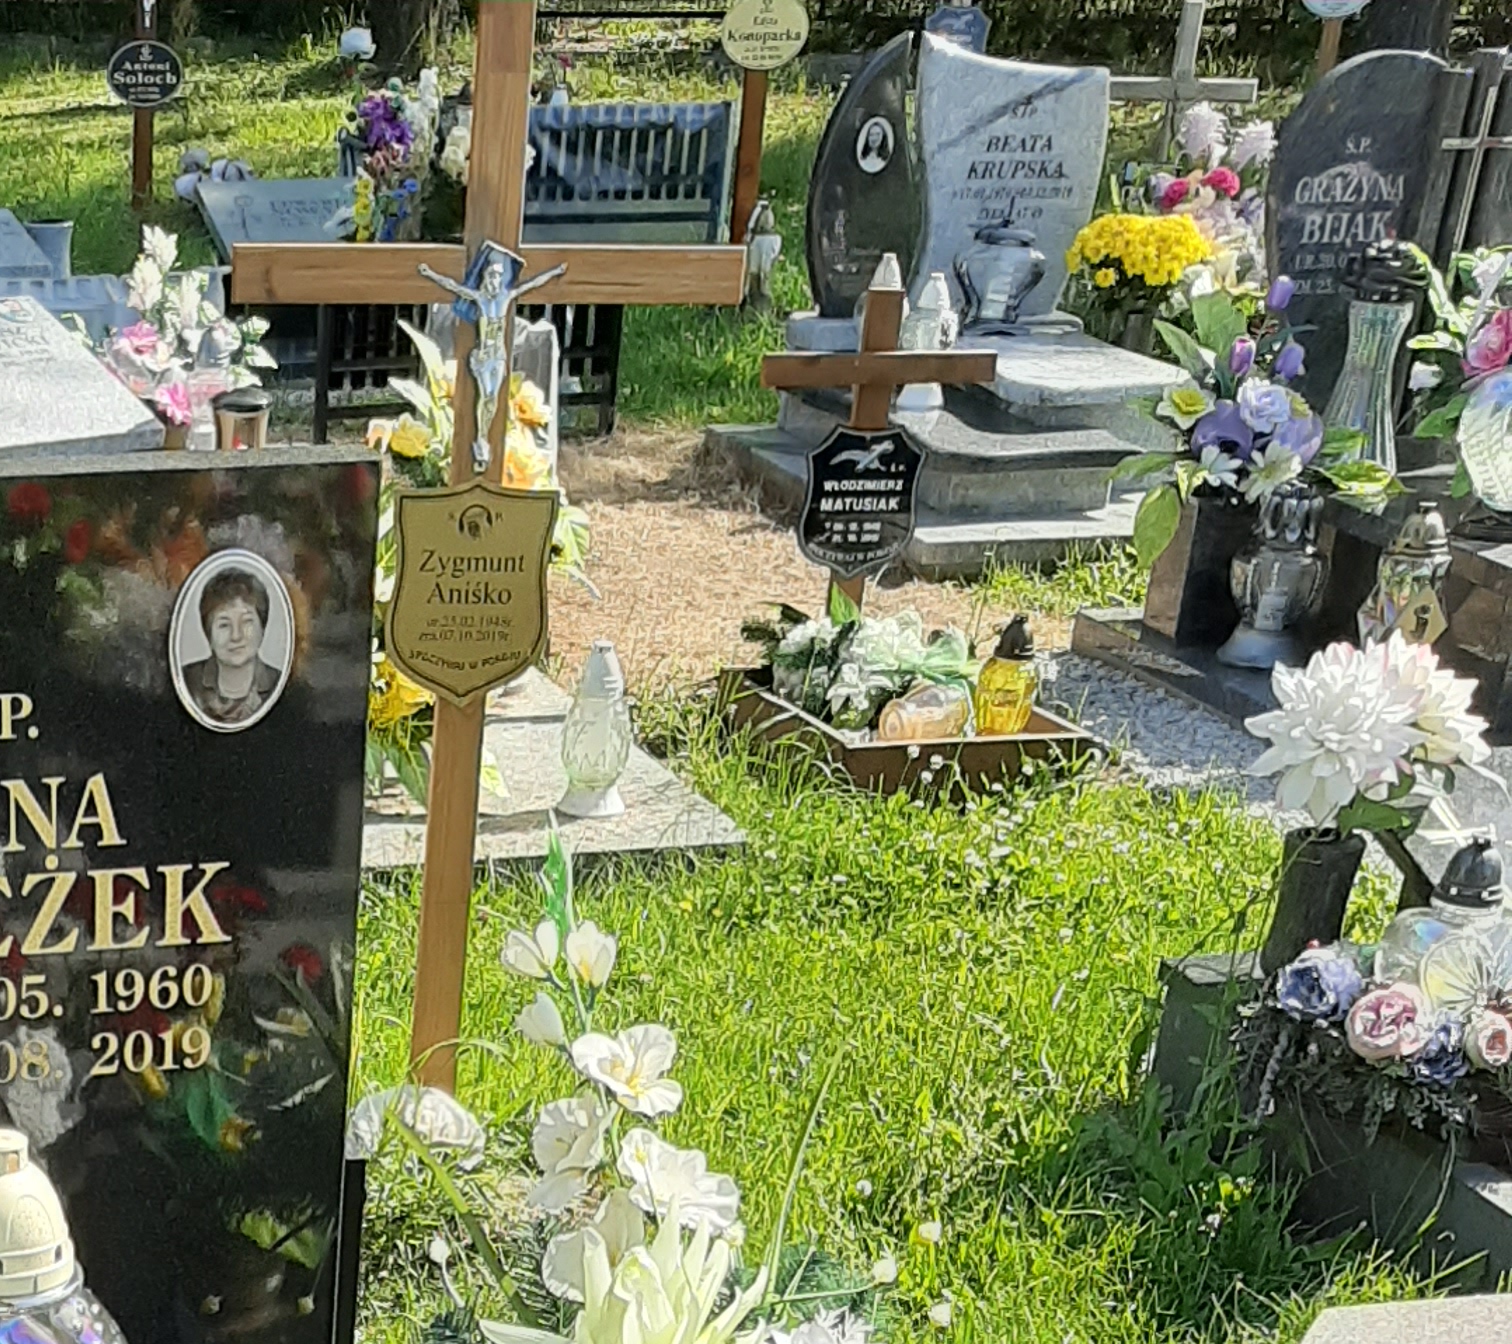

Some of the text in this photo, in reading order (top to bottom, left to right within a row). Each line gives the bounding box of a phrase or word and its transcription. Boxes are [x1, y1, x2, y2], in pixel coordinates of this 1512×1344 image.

[986, 134, 1053, 153] BEATA
[967, 160, 1070, 180] KRUPSKA
[1295, 170, 1405, 204] GRAŻYNA
[1299, 210, 1393, 245] BIJAK
[823, 480, 904, 492] WŁODZIMIERZ
[820, 497, 901, 512] MATUSIAK
[419, 550, 525, 578] Zygmunt
[426, 582, 512, 605] Aniśko
[90, 964, 213, 1015] 1960
[90, 1027, 212, 1077] 2019
